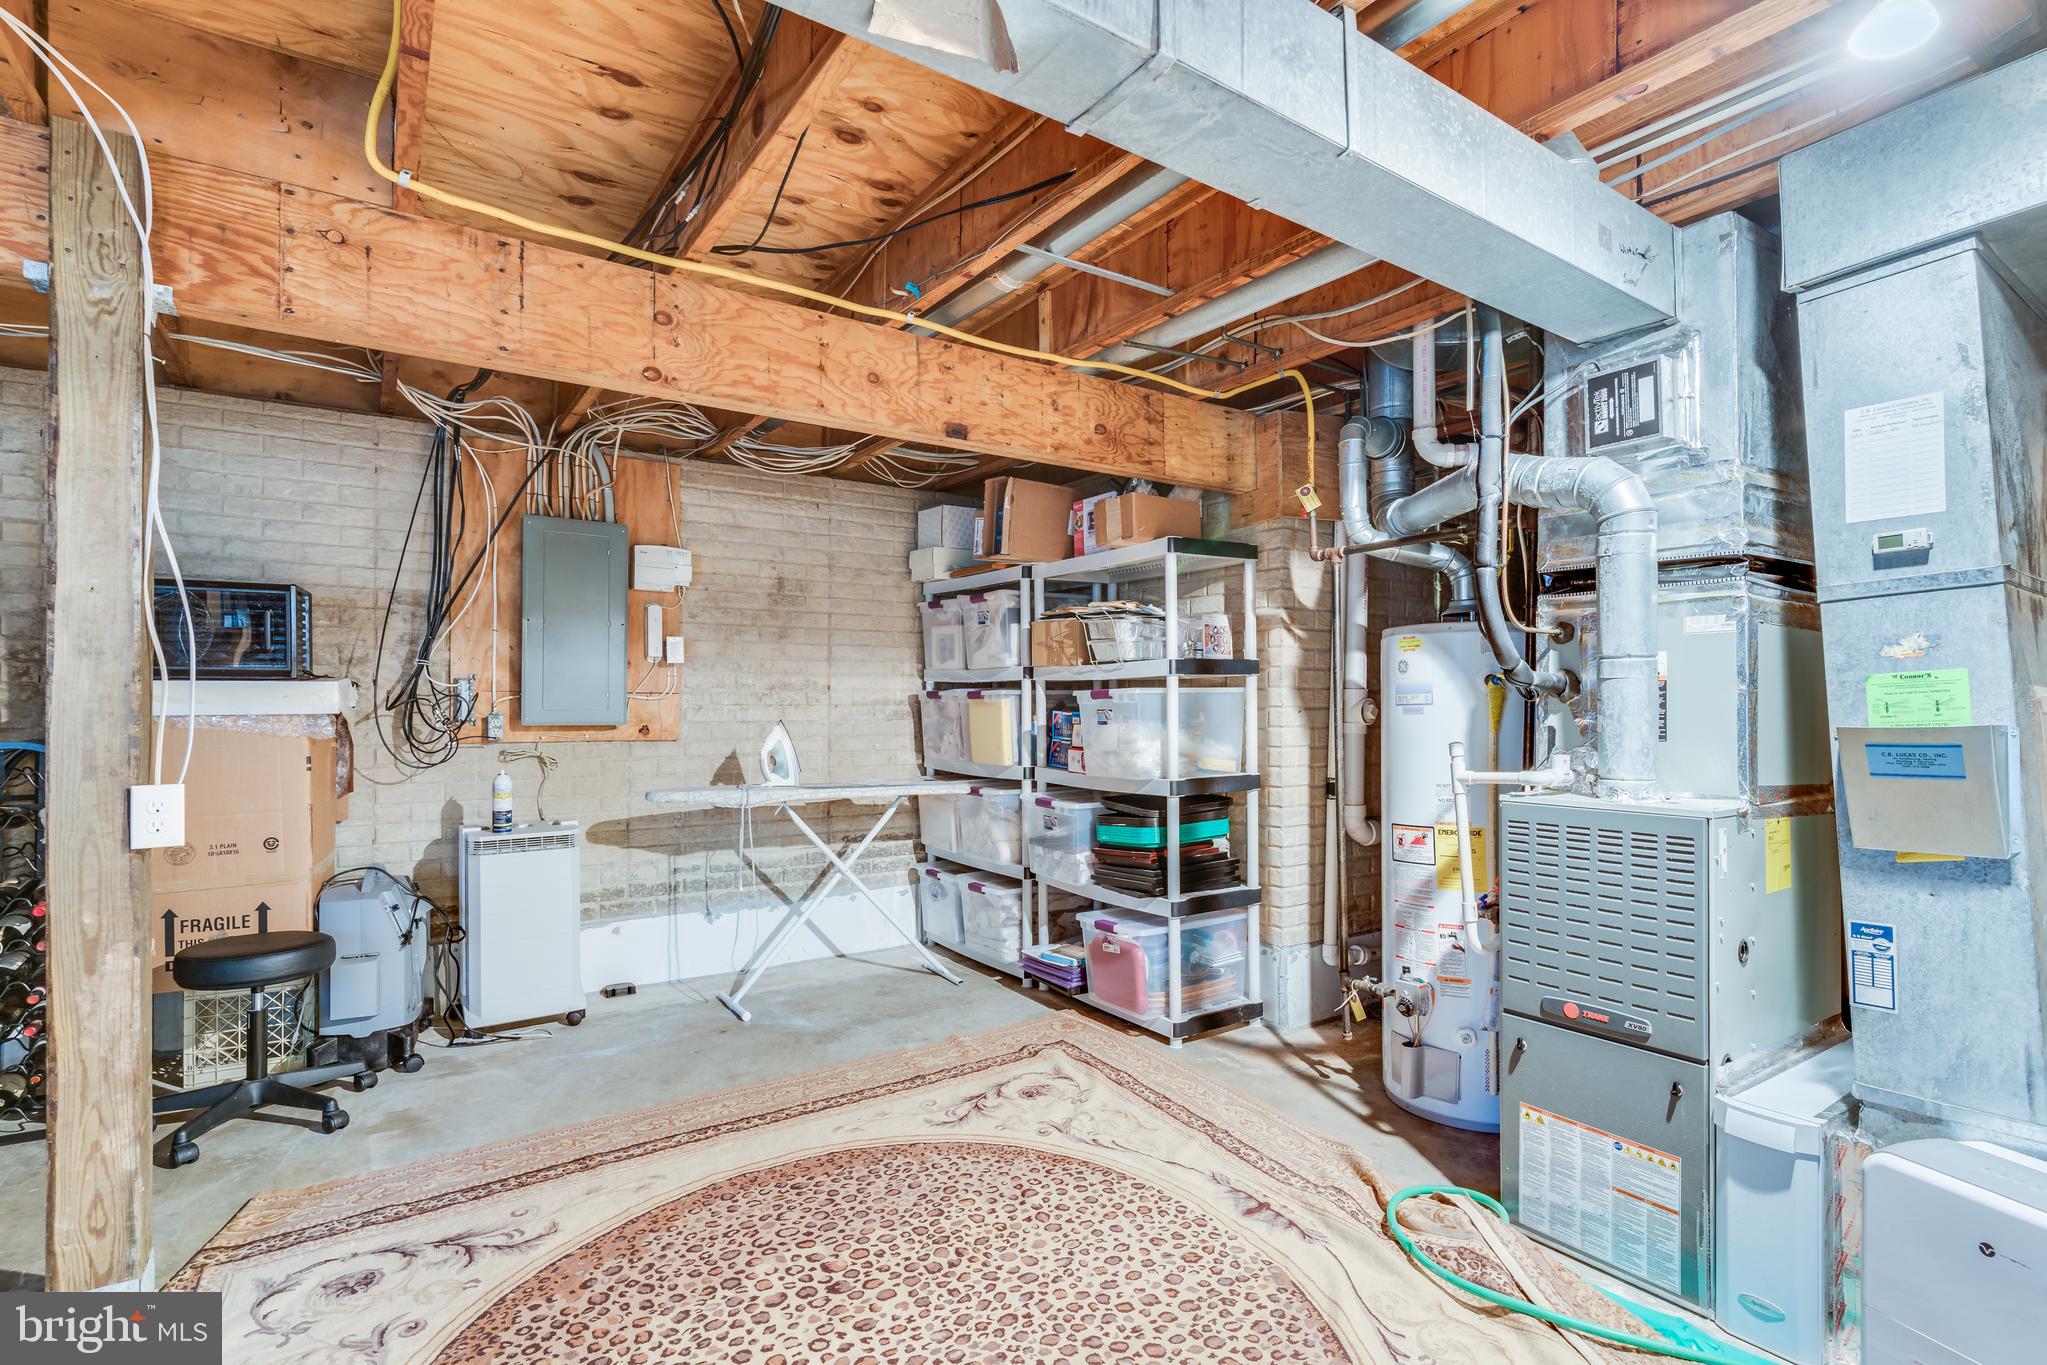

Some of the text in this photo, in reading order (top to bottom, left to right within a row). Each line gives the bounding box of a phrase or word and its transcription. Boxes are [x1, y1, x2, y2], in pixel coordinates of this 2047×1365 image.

[180, 914, 251, 934] FRAGILE
[1582, 1010, 1610, 1023] TRANE
[1627, 1022, 1647, 1032] XV80
